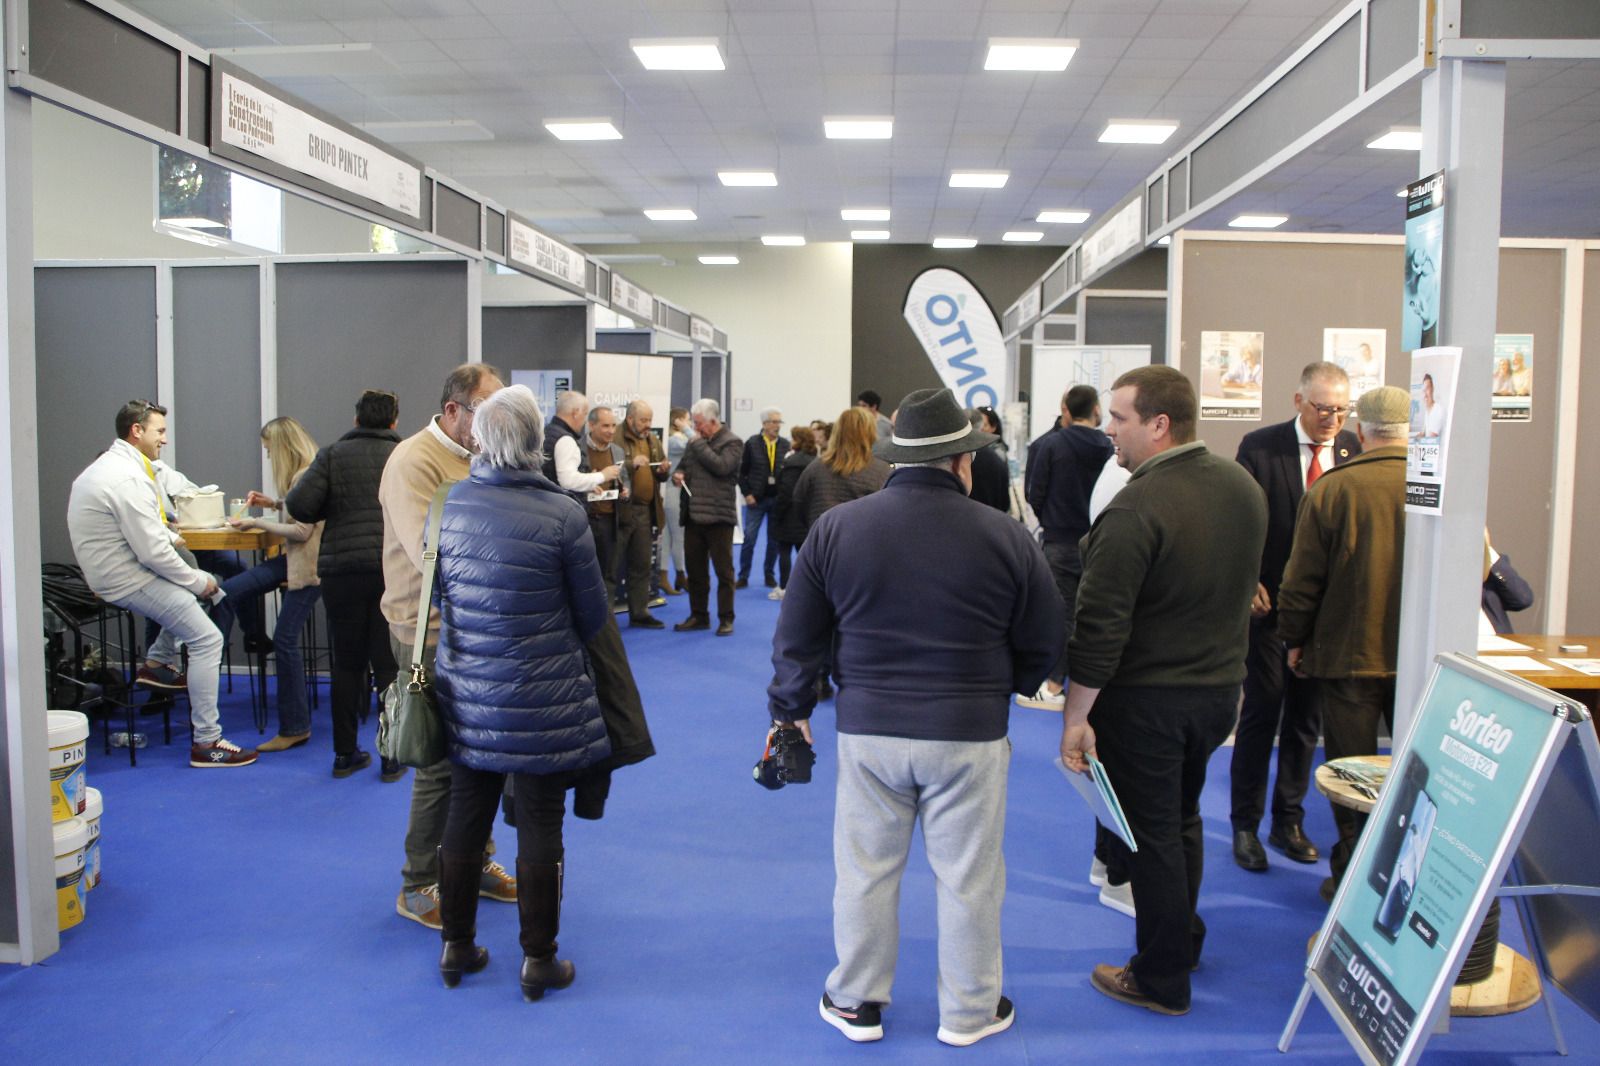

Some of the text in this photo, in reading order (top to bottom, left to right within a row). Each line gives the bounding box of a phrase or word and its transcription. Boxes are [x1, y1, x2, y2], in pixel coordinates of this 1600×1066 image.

[308, 132, 369, 181] GRUPO PINTEX
[1450, 699, 1513, 755] Sorteo
[1347, 953, 1393, 1016] WICO
